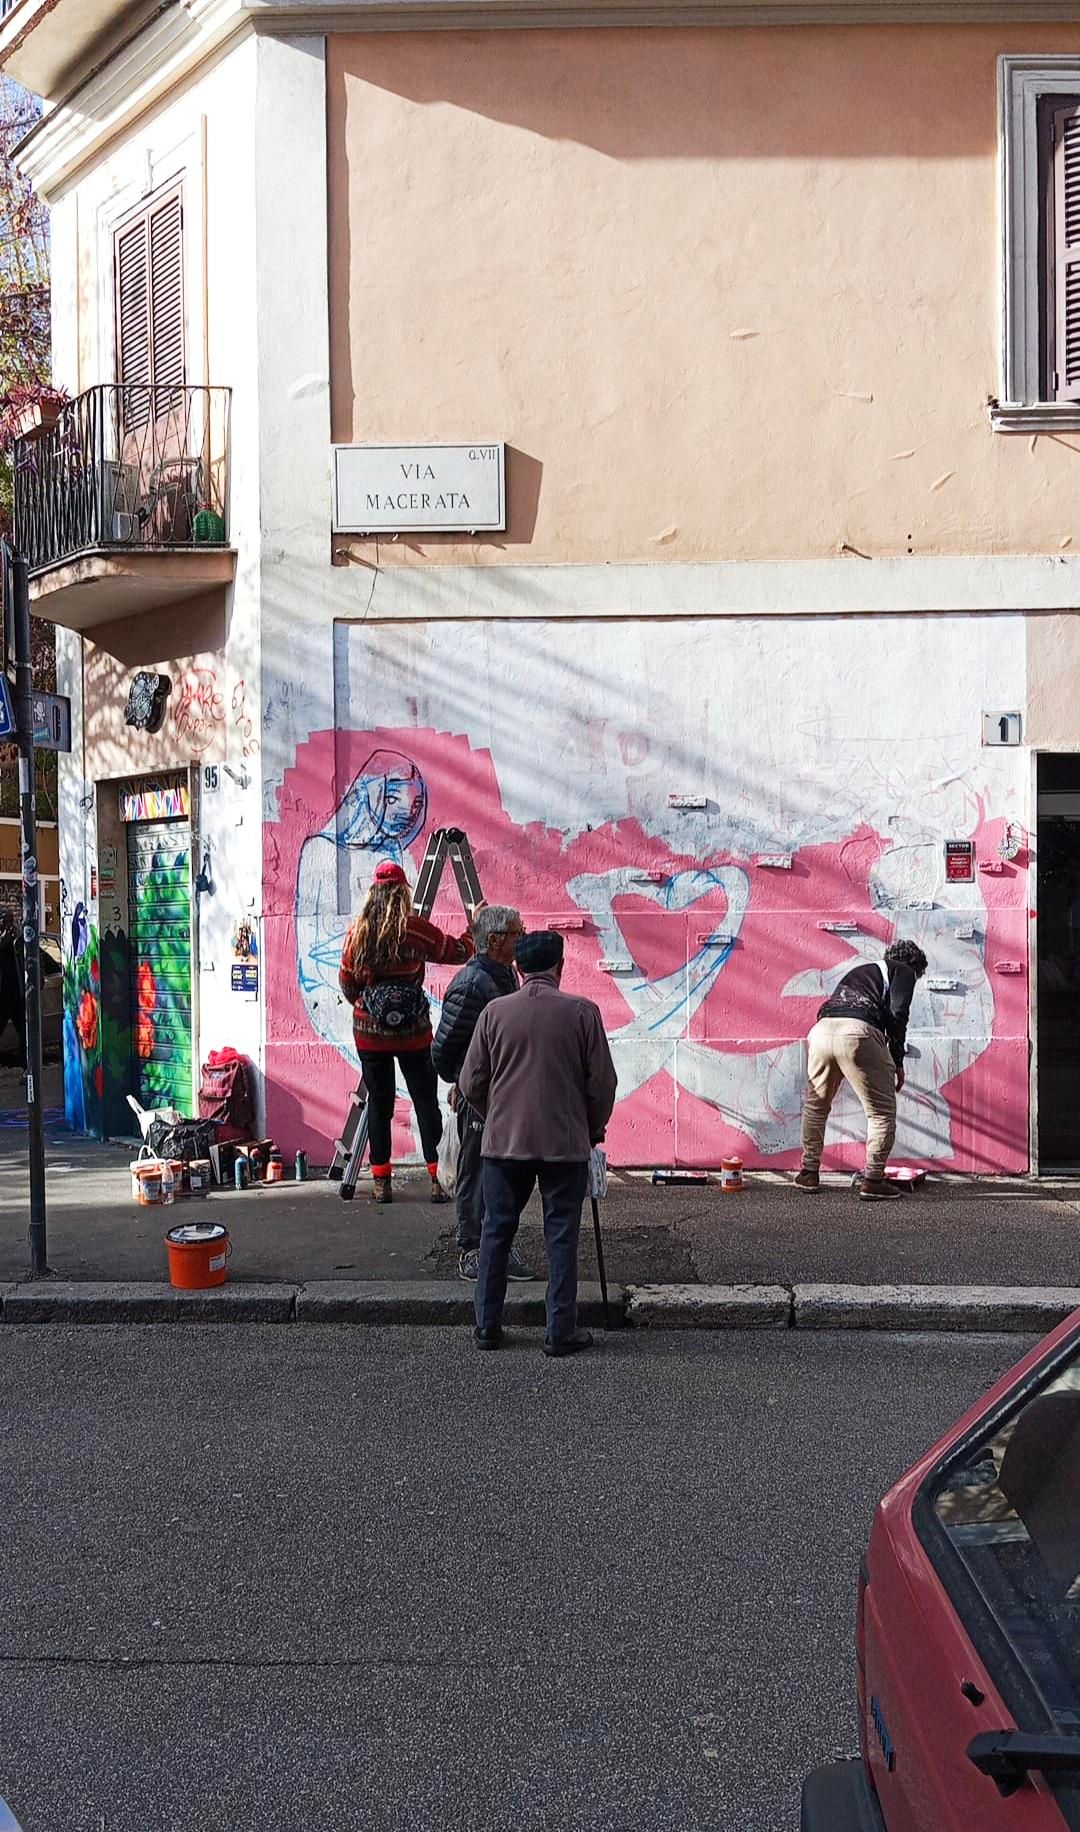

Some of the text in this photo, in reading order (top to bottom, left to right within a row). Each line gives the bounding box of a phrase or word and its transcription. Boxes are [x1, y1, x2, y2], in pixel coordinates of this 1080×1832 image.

[400, 464, 436, 480] VIA
[366, 493, 470, 510] MACERATA
[998, 716, 1008, 742] 1
[205, 765, 218, 788] 95
[112, 907, 122, 921] 3
